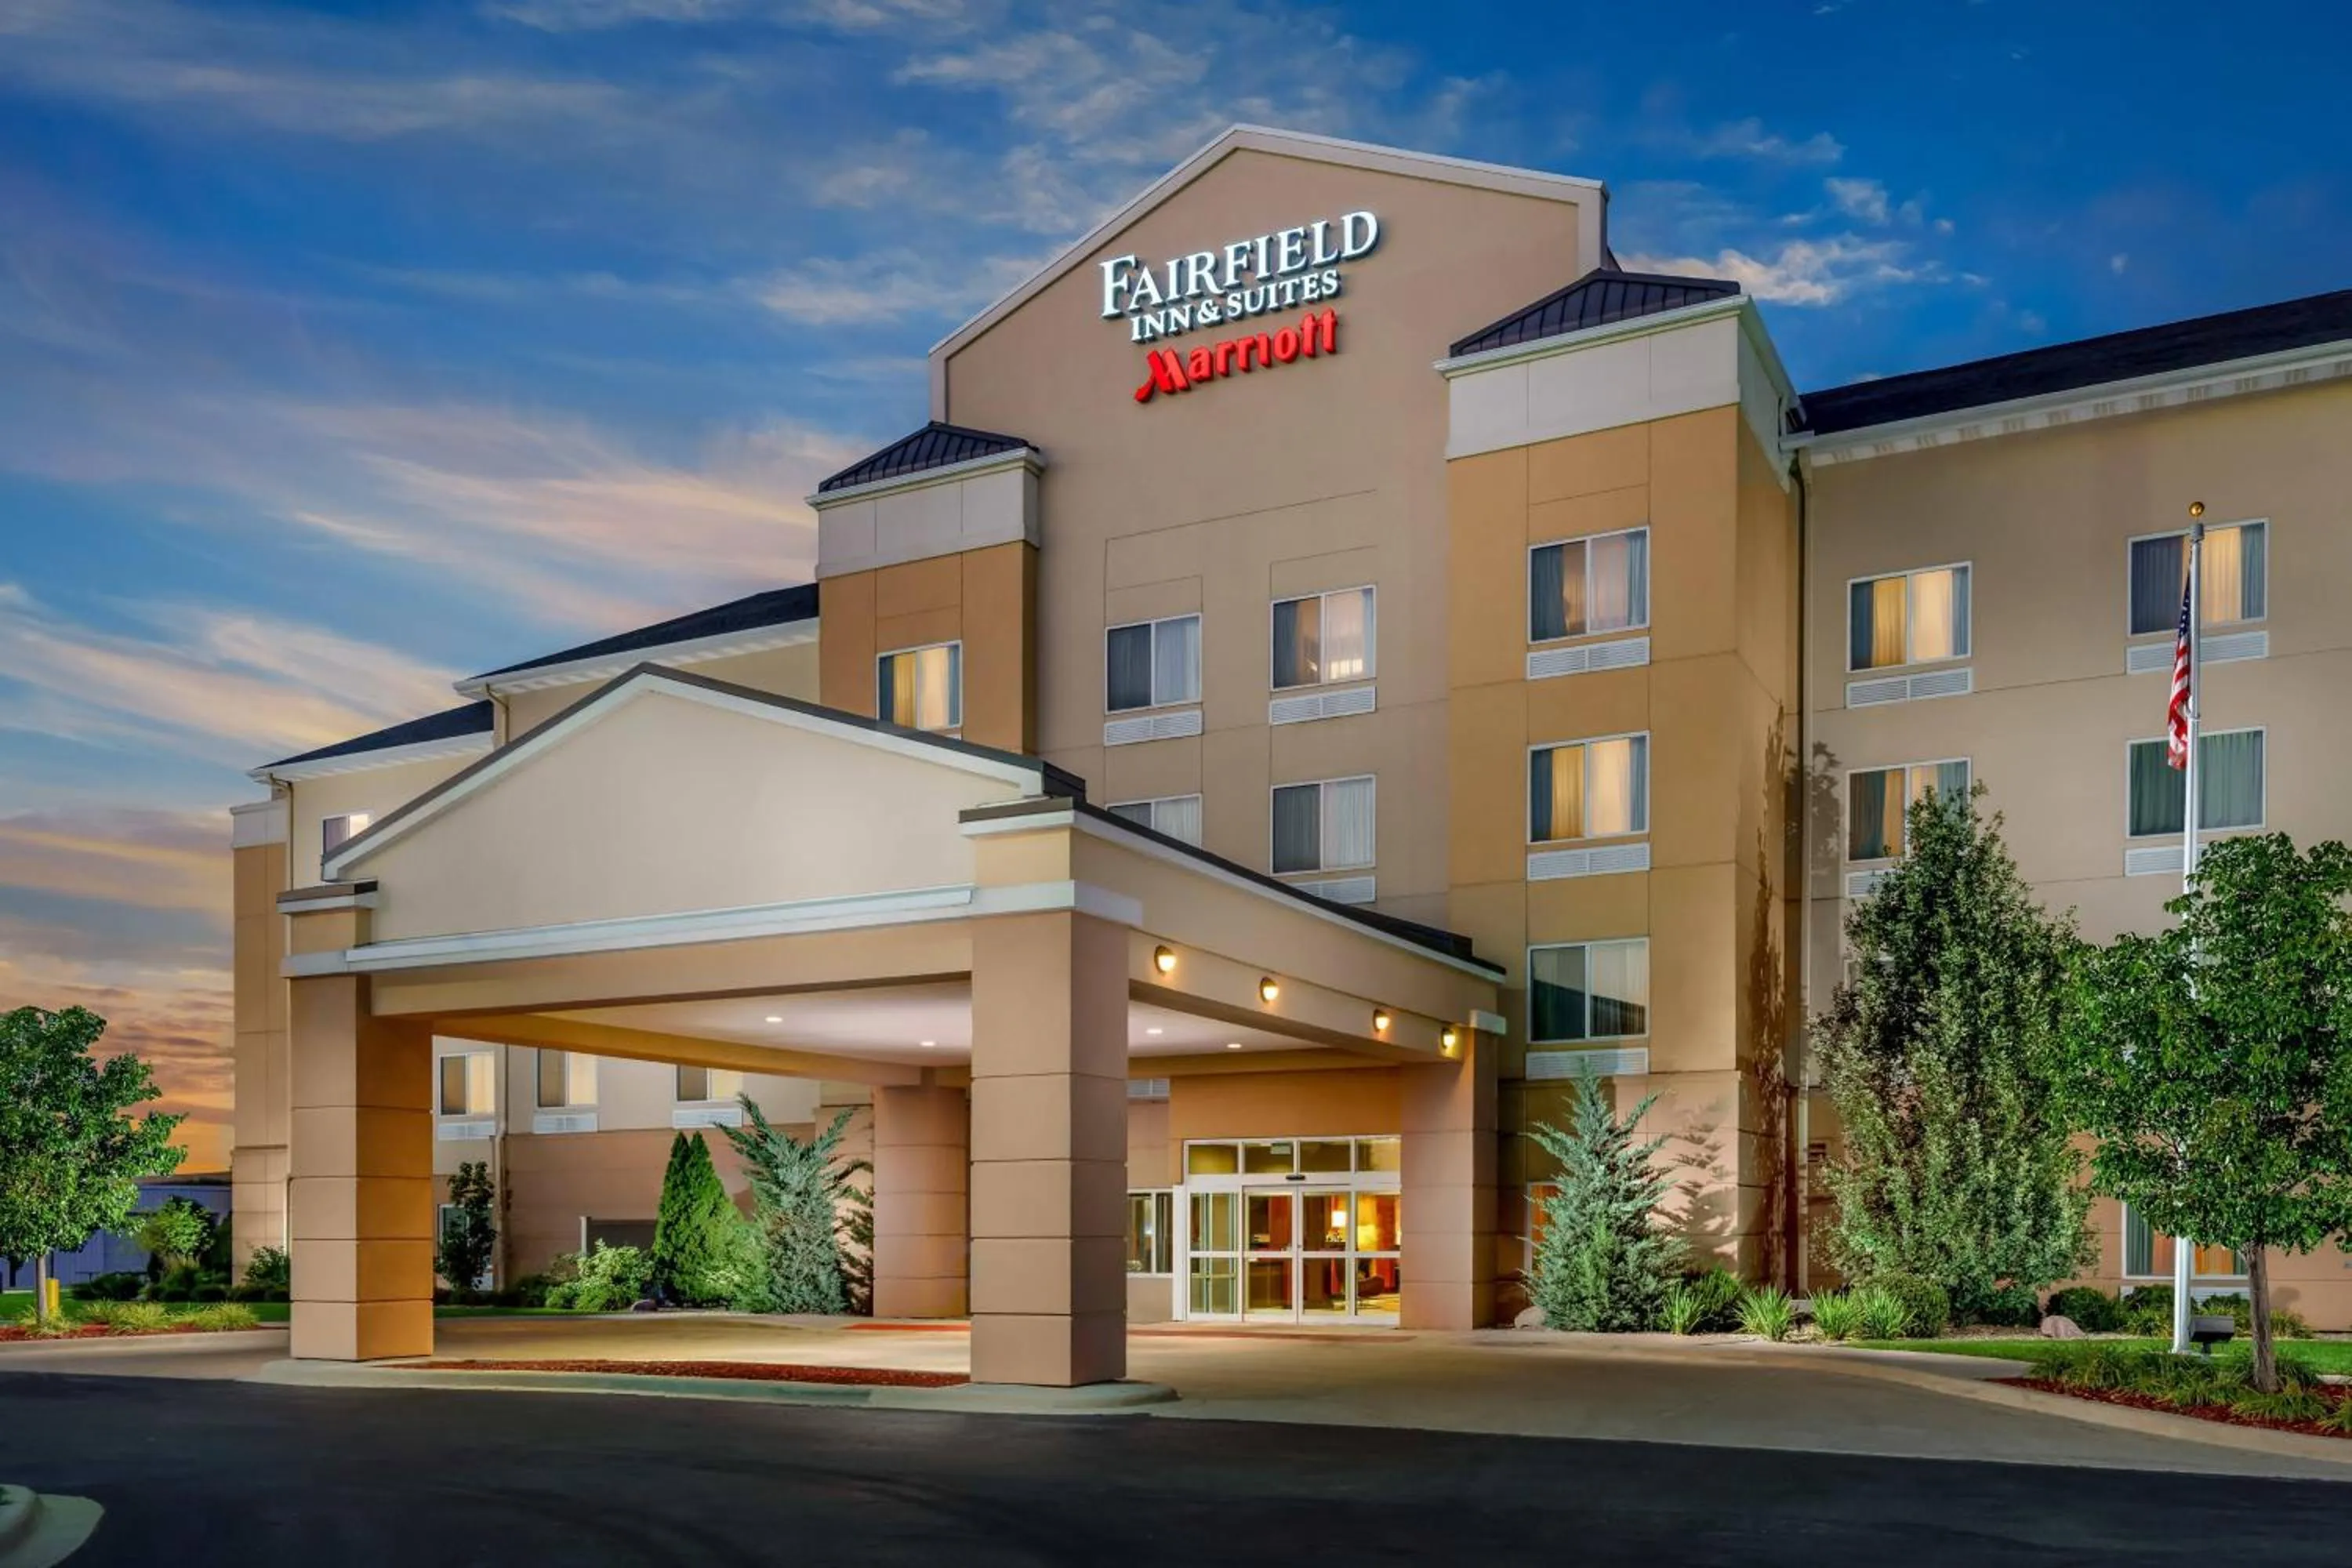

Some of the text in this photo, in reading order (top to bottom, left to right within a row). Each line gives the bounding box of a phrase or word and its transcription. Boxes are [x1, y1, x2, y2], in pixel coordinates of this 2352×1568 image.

[1099, 210, 1380, 319] FAIRFIELD
[1130, 270, 1341, 343] INN & SUITES
[1134, 307, 1338, 403] Marriott
